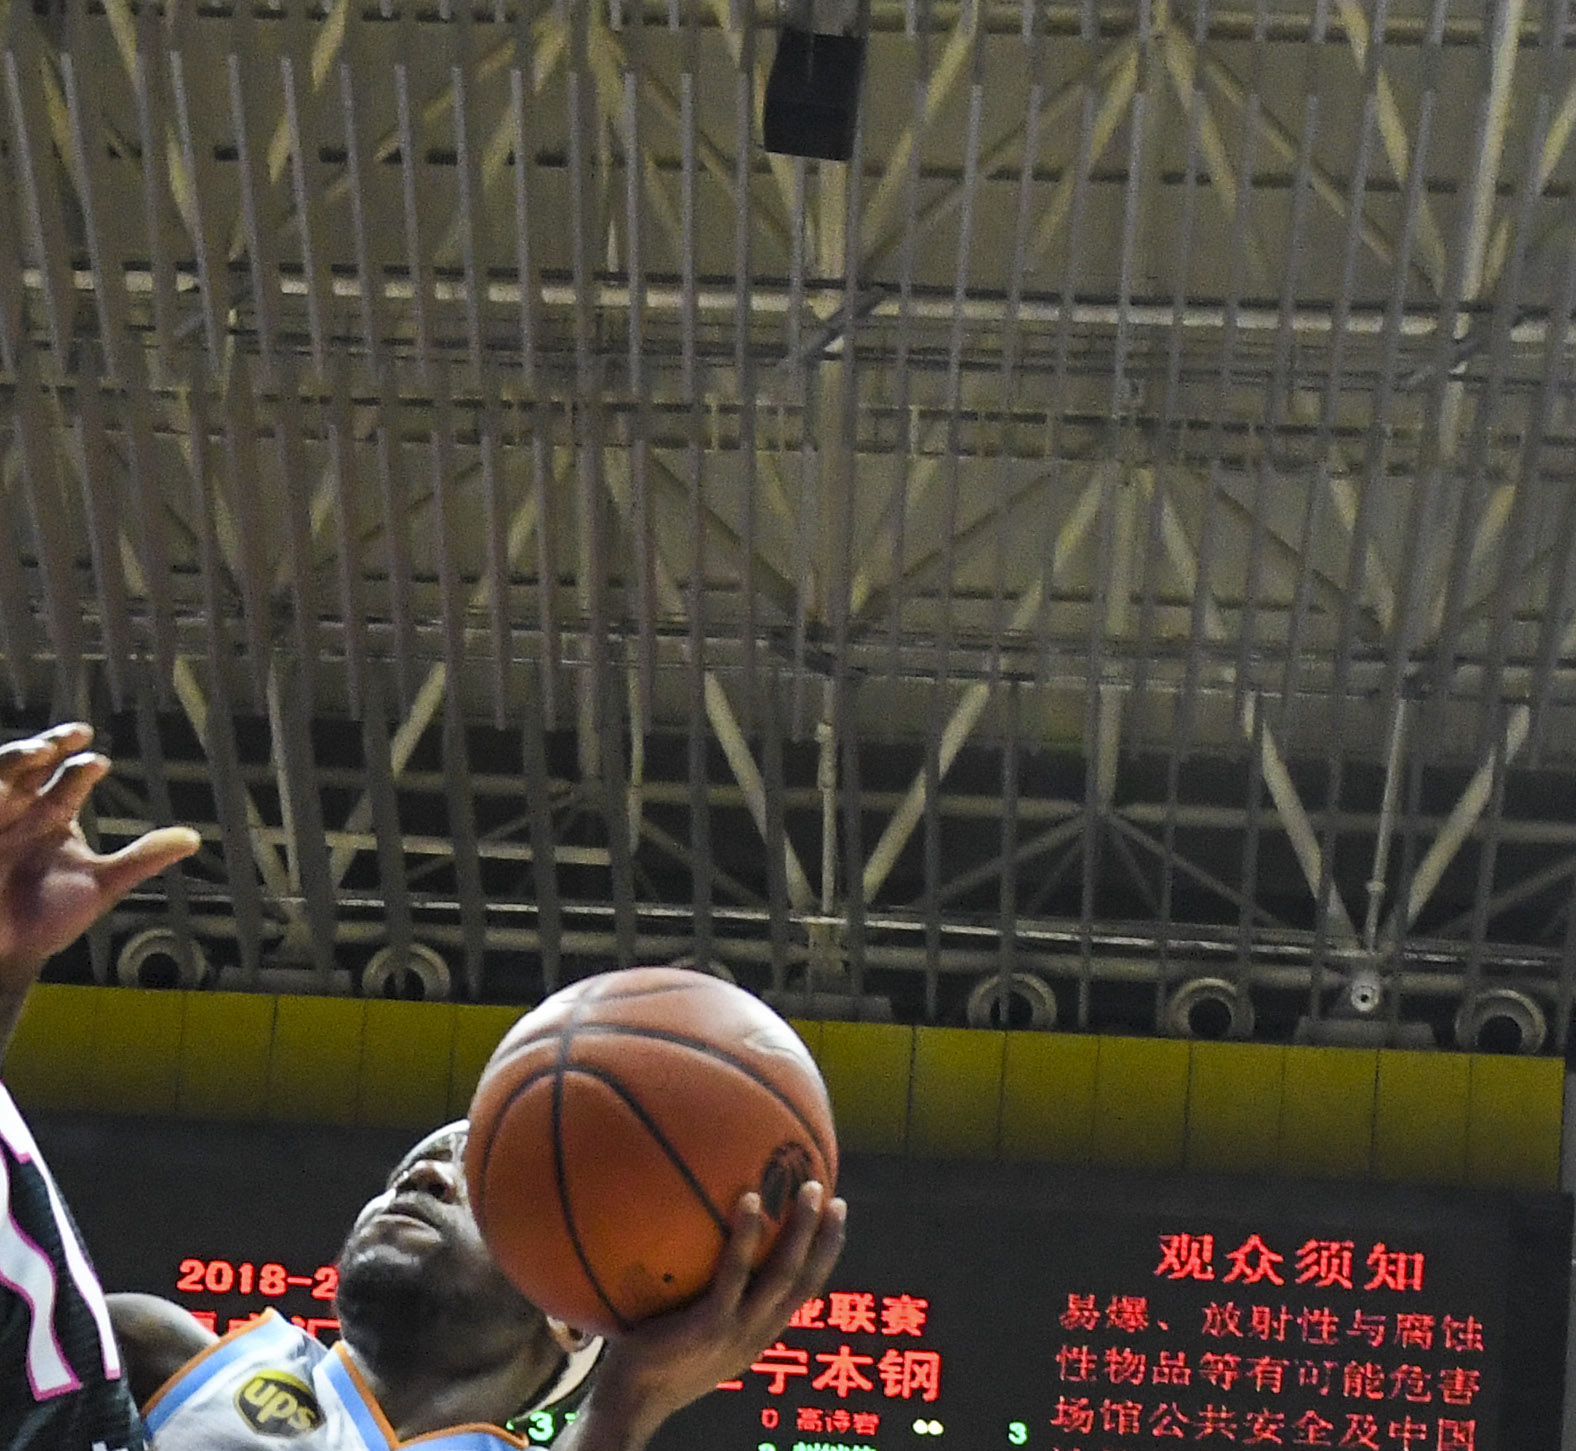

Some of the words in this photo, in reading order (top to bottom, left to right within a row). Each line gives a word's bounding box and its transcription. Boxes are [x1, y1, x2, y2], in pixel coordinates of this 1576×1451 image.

[1154, 1232, 1425, 1292] 观众须知
[1055, 1344, 1481, 1406] 性物品等有可能危害
[244, 1379, 316, 1430] ups
[761, 1408, 779, 1430] 0
[1008, 1420, 1028, 1445] 3
